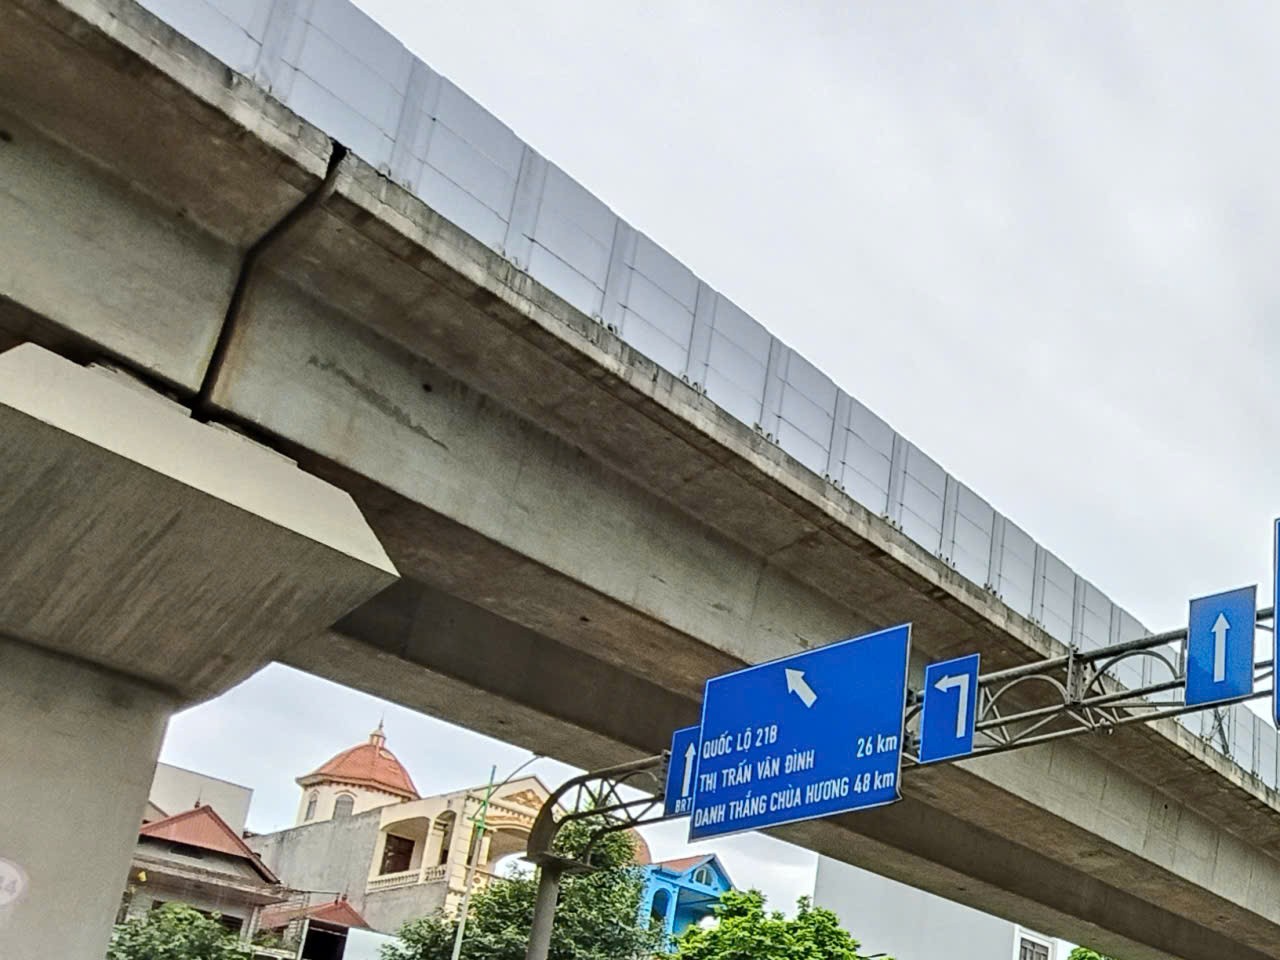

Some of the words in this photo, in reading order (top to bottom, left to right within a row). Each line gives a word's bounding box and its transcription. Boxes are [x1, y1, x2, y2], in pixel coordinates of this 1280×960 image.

[700, 772, 717, 794] THỊ
[721, 765, 752, 789] TRẤN
[784, 749, 815, 775] ĐÌNH
[856, 736, 874, 759] 26
[876, 734, 898, 753] km
[702, 732, 733, 760] QUỐC
[736, 726, 752, 752] LỘ
[755, 724, 778, 746] 21B
[675, 797, 693, 814] BRT
[694, 805, 725, 829] DANH
[729, 790, 767, 820] THẮNG
[769, 783, 801, 812] CHÙA
[805, 776, 850, 805] HƯƠNG
[853, 772, 871, 795] 48
[873, 770, 895, 790] km
